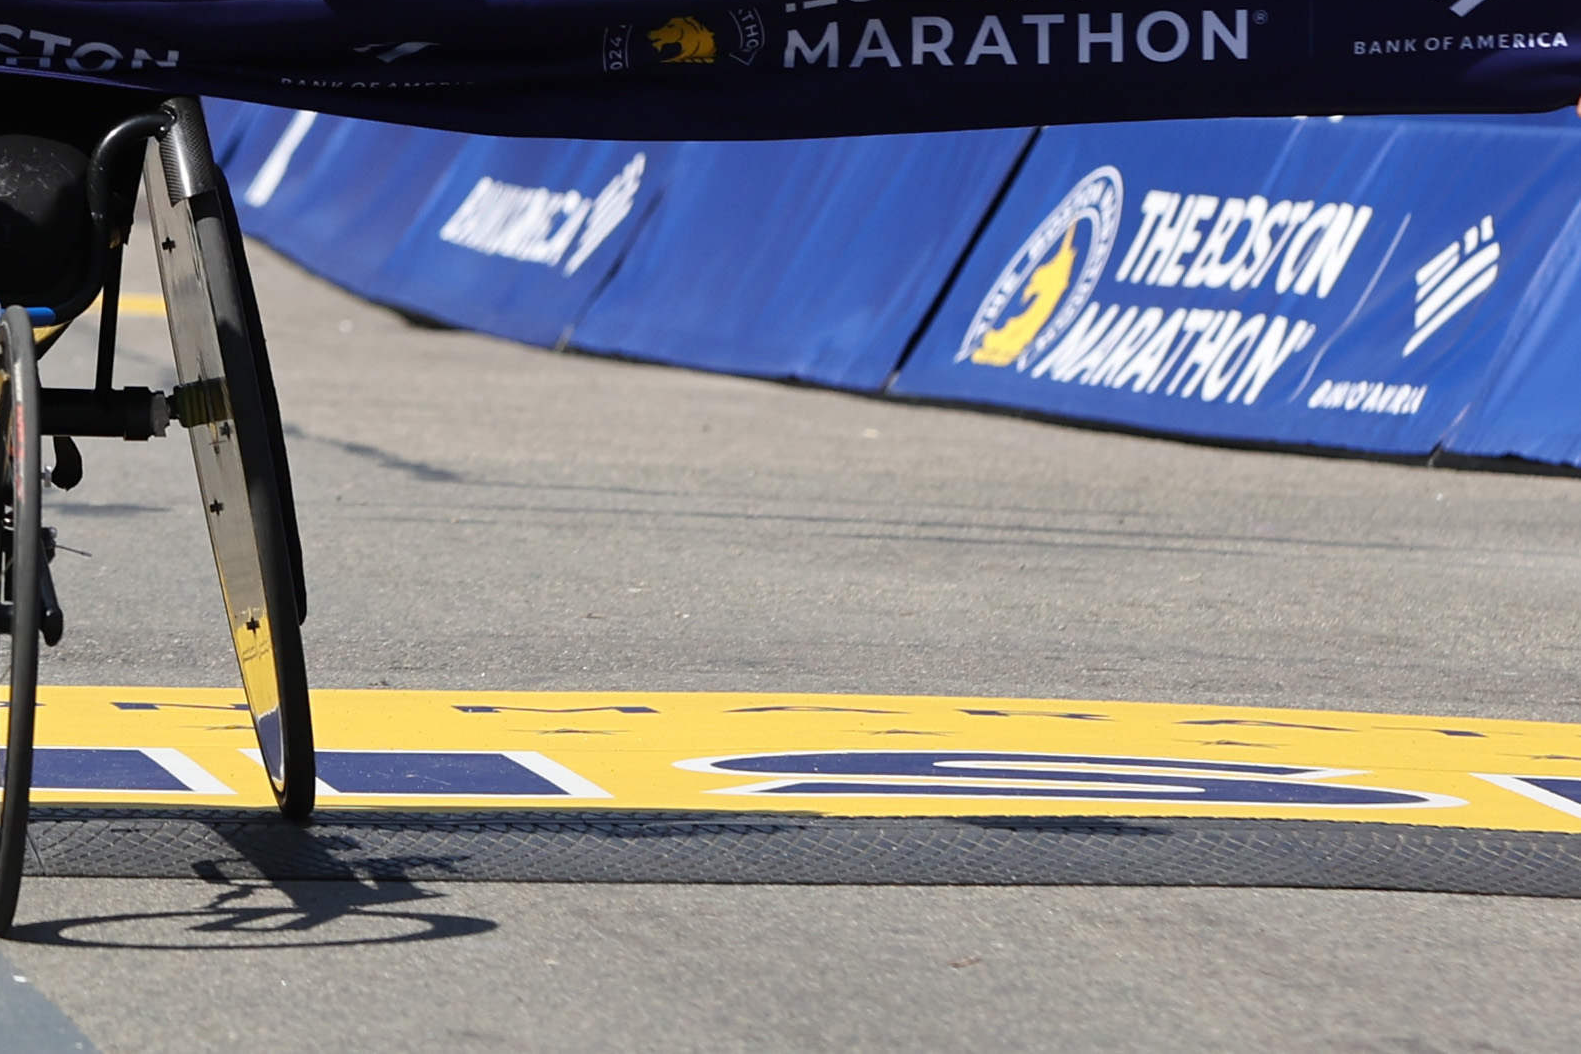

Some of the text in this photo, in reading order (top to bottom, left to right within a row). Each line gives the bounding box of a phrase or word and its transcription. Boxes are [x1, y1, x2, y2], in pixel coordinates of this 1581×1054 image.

[1353, 31, 1569, 55] BANK OF AMERICA
[1116, 189, 1220, 288] THE
